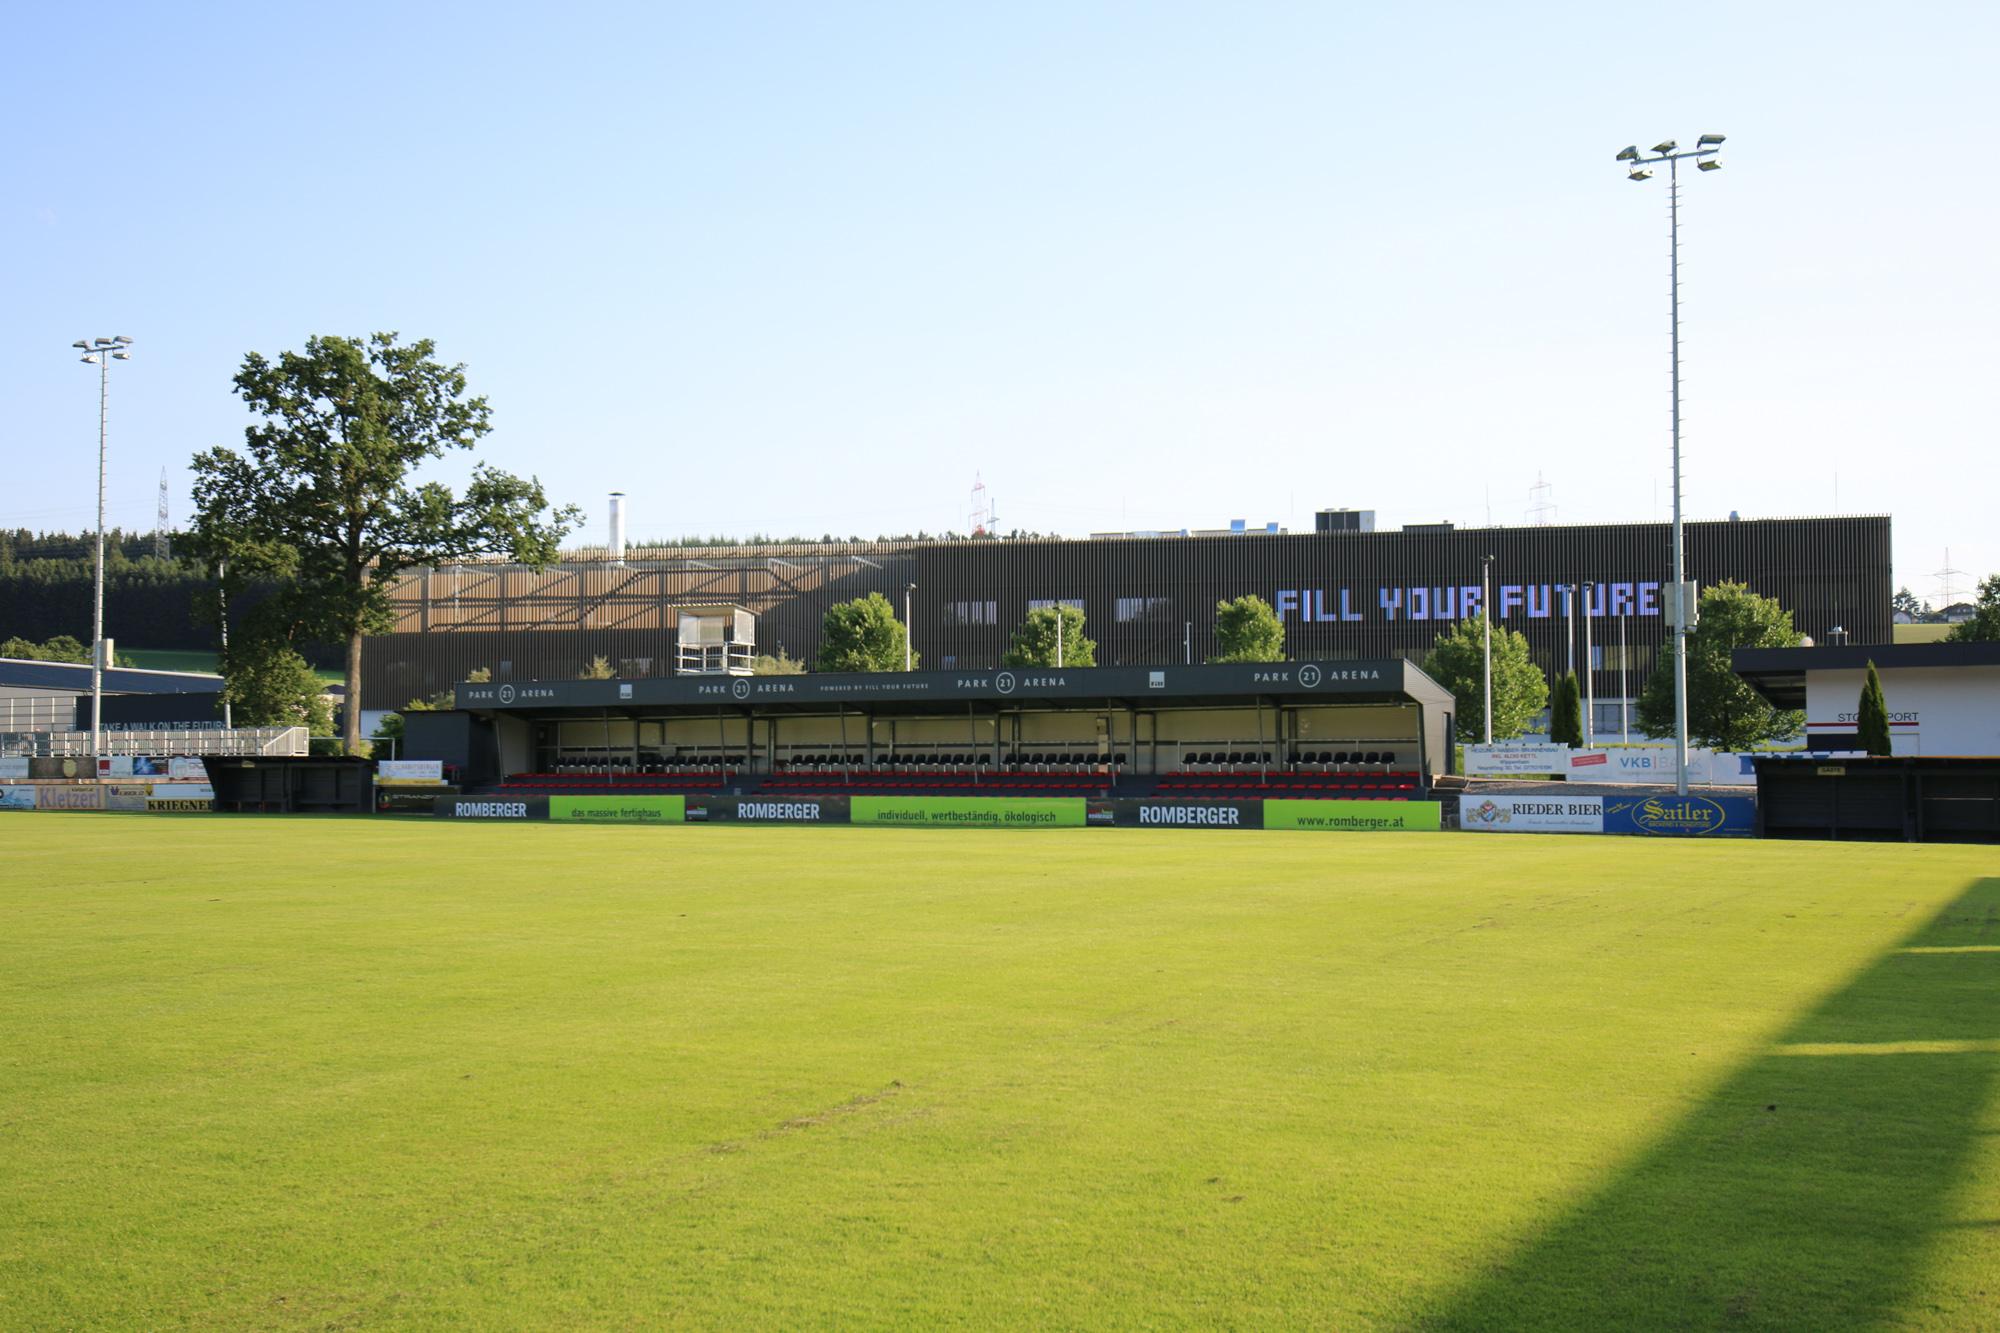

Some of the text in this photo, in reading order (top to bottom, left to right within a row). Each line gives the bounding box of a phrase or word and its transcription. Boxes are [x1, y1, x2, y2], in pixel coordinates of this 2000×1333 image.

[1277, 581, 1660, 622] FILL YOUR FUTURE
[957, 677, 1066, 688] PARK 21 ARENA
[1254, 670, 1380, 682] PARK 21 ARENA
[469, 689, 554, 699] PARK 21 ARENA
[699, 683, 794, 694] PARK 21 ARENA
[1838, 712, 1919, 722] STOPORT
[100, 722, 121, 732] TAKE
[122, 722, 129, 731] A
[130, 722, 156, 731] WALK
[158, 721, 170, 731] ON
[173, 721, 190, 731] THE
[1620, 757, 1651, 768] VKB
[1659, 757, 1702, 769] BAK
[40, 787, 100, 808] Kletzerl
[455, 802, 527, 818] ROMBERGER
[571, 807, 662, 820] das massive fertighaus
[738, 803, 820, 819] ROMBERGER
[1140, 806, 1239, 824] ROMBERGER
[1513, 803, 1564, 815] RIEDER
[1568, 804, 1602, 816] BIER
[1638, 799, 1713, 824] Sailer
[877, 809, 1057, 824] individuell, wertbeständig, ökologisch
[1297, 815, 1405, 829] www.romberger.at
